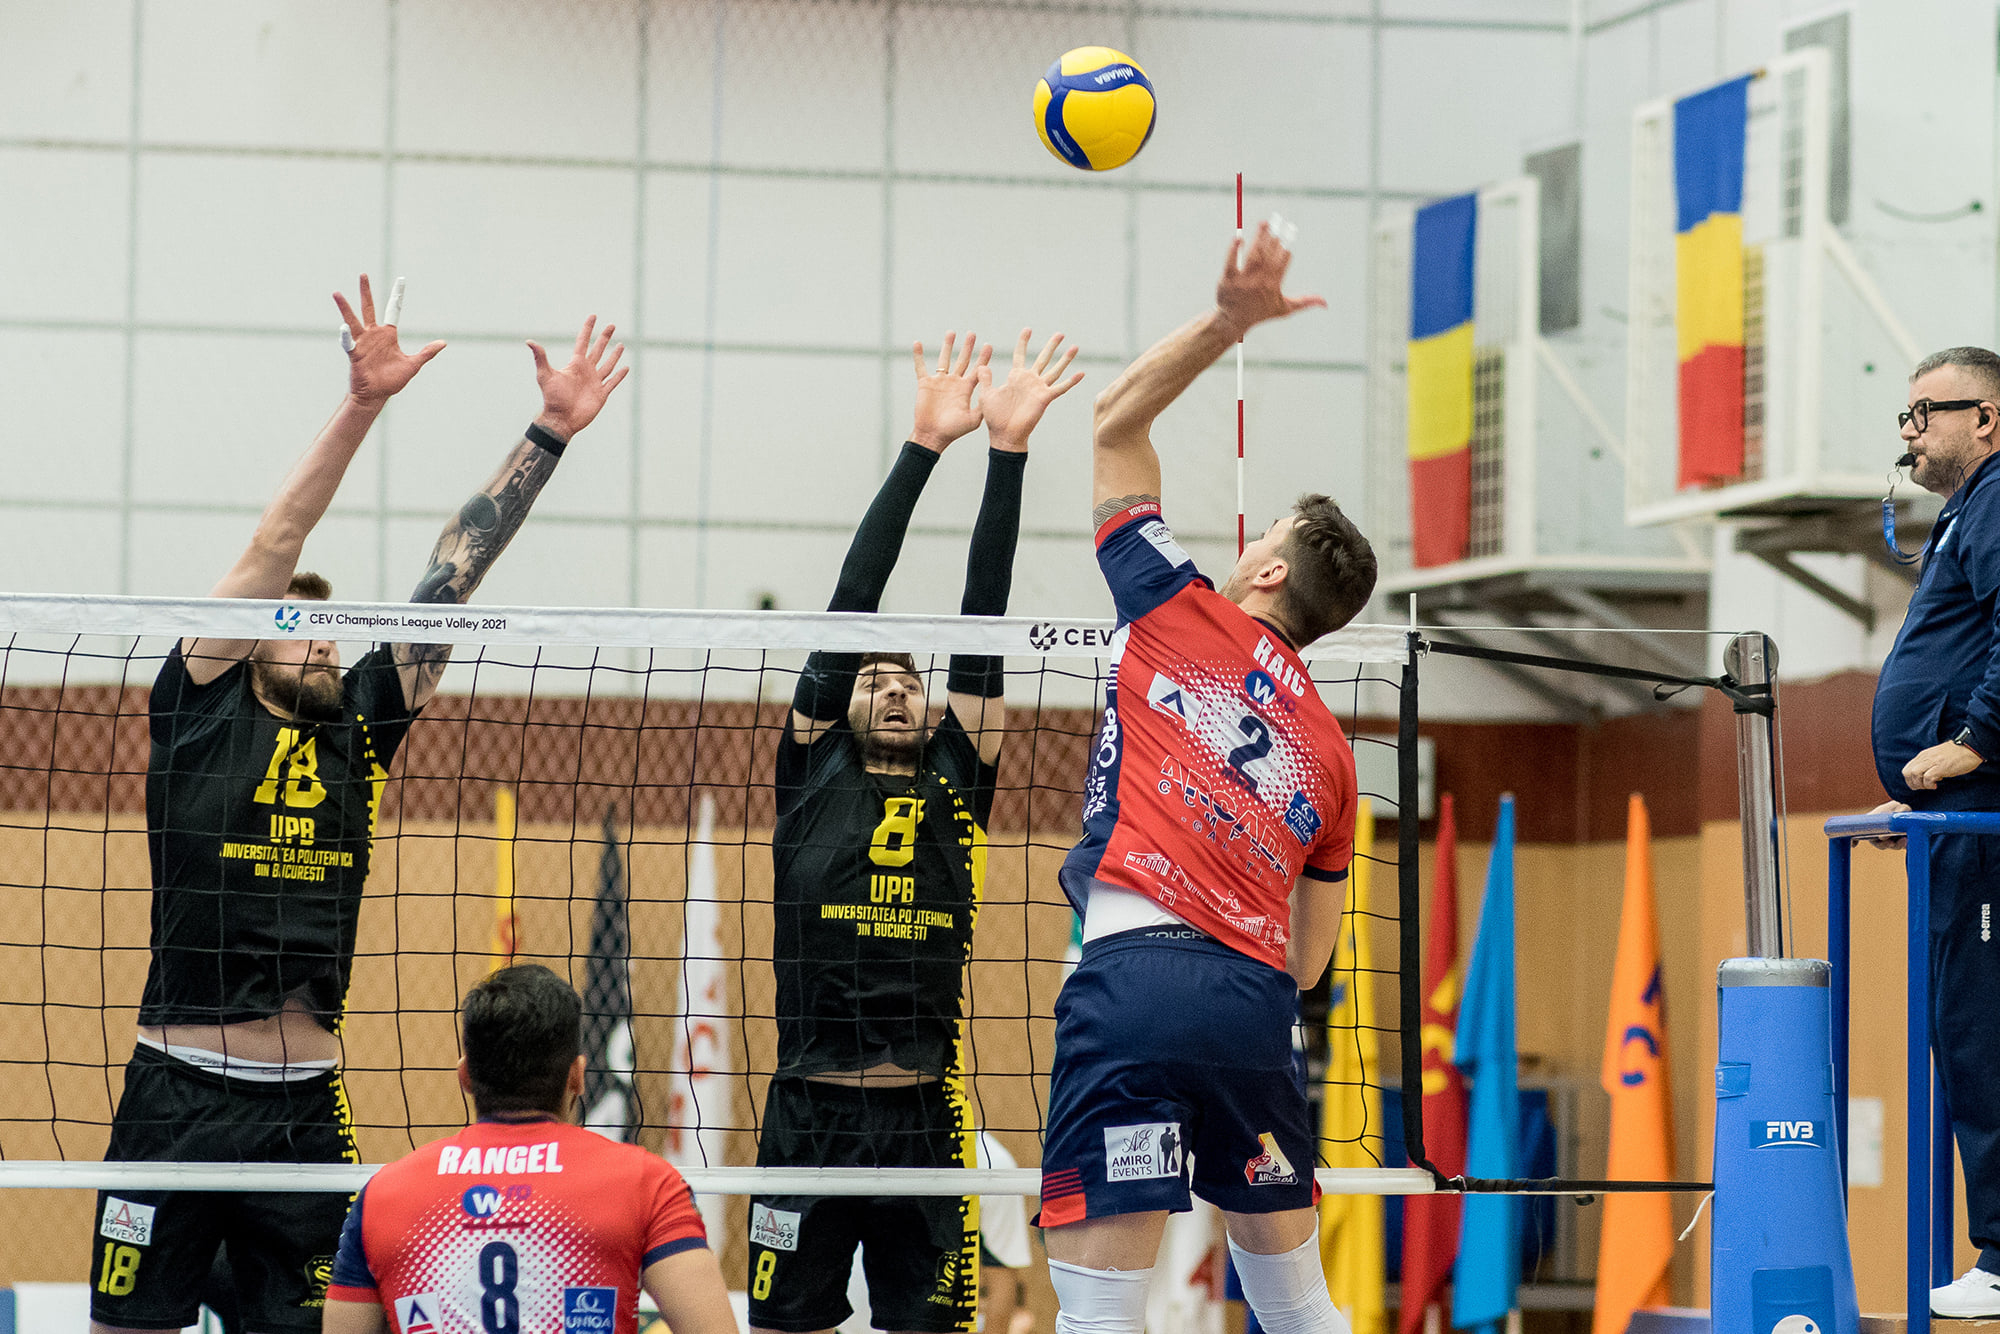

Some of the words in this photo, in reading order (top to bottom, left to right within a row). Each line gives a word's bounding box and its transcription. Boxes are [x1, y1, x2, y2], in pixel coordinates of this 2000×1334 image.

[310, 614, 334, 625] CEV
[336, 615, 398, 628] Champions
[401, 616, 442, 630] League
[445, 617, 479, 631] Volley
[482, 619, 506, 630] 2021
[1064, 628, 1114, 646] CEV
[1096, 706, 1118, 768] PRO
[253, 727, 327, 808] 18
[1227, 715, 1274, 802] 2
[270, 814, 315, 845] UPB
[868, 797, 926, 867] 8
[1160, 755, 1292, 879] ARCADA
[254, 863, 270, 877] DIN
[870, 874, 915, 905] UPB
[821, 904, 896, 924] UNIVERSITATEA
[1767, 1121, 1814, 1139] FIVB
[437, 1141, 563, 1175] RANGEL
[1112, 1154, 1152, 1168] AMIRO
[1112, 1166, 1152, 1178] EVENTS
[1258, 1173, 1294, 1183] ARCADA
[103, 1224, 146, 1243] AMVEKO
[754, 1231, 793, 1249] AMVEKO
[98, 1242, 141, 1296] 18
[753, 1250, 777, 1300] 8
[479, 1241, 520, 1334] 8
